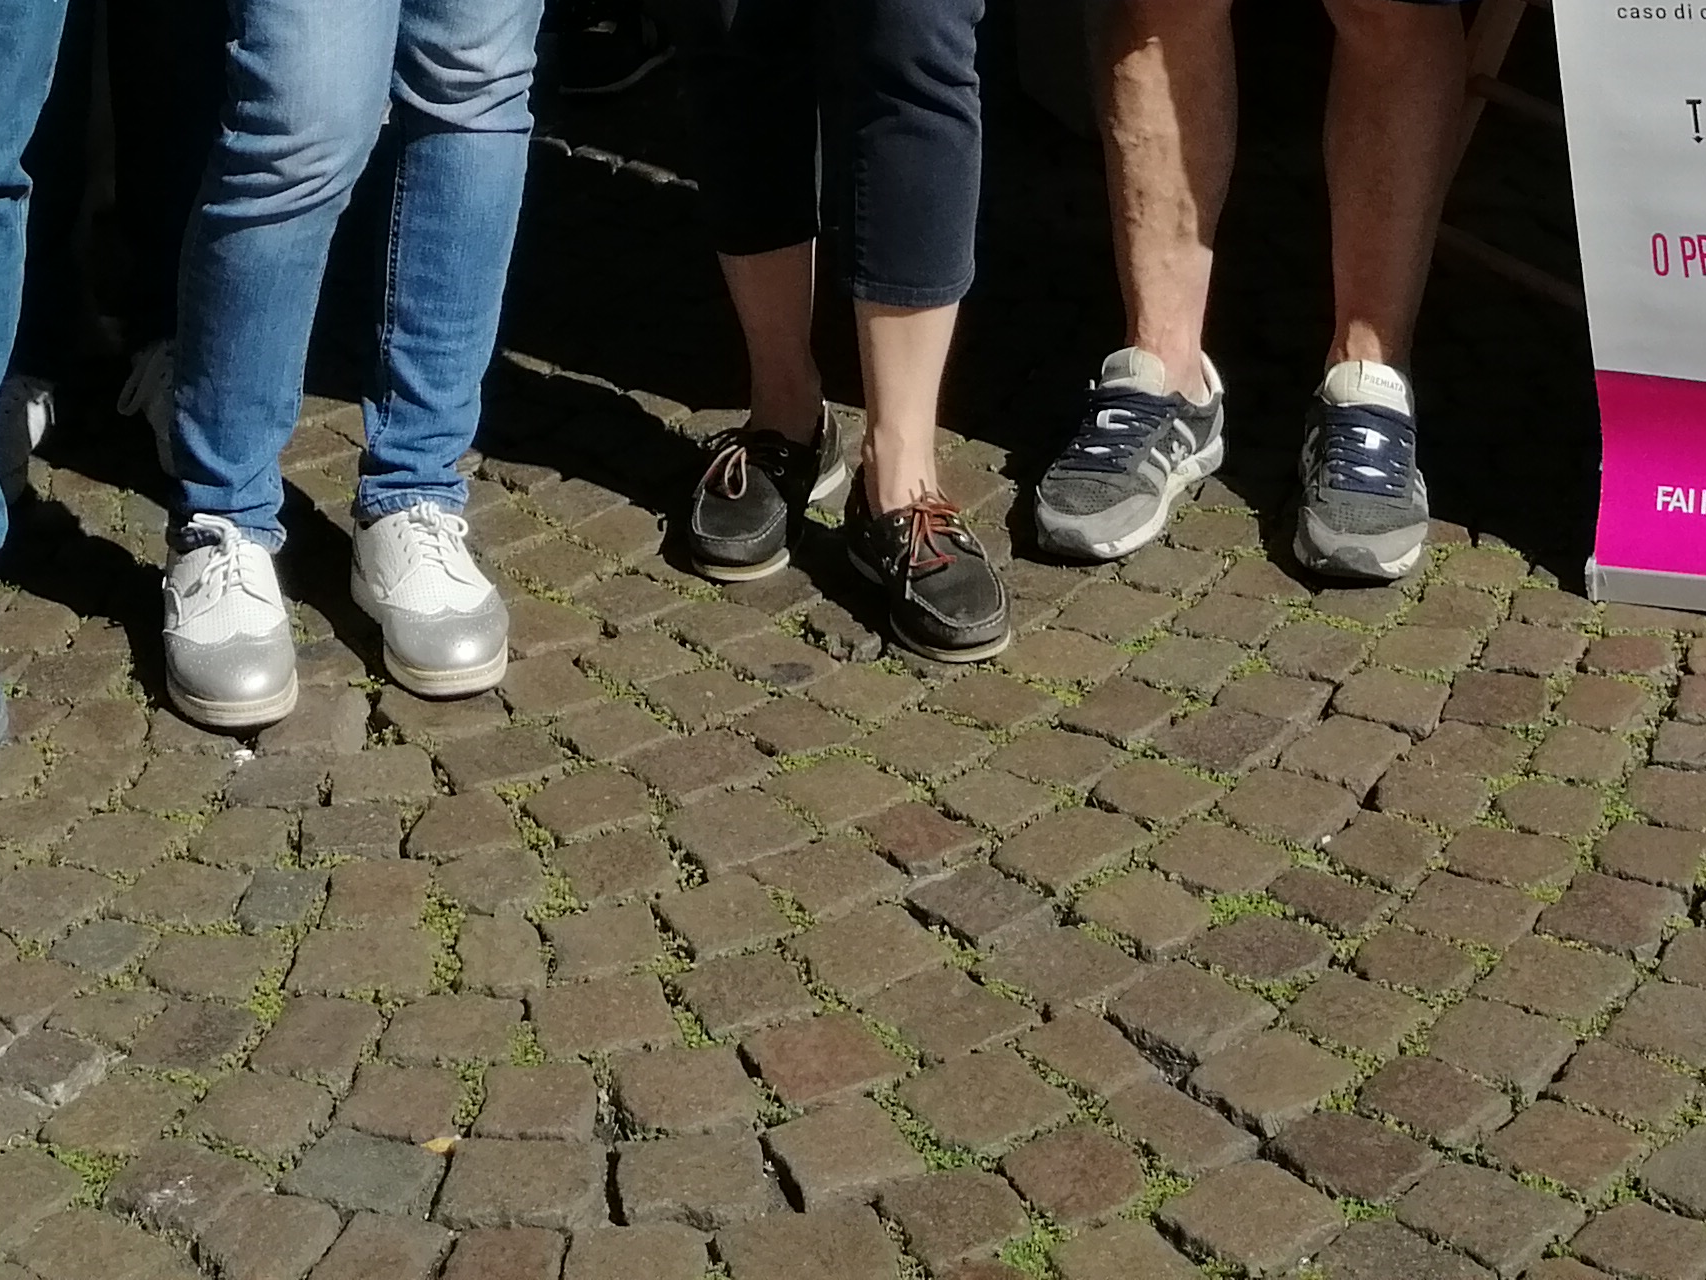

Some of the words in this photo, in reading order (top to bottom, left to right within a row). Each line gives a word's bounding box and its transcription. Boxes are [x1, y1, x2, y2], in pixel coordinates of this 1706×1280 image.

[1652, 233, 1669, 276] O
[1363, 373, 1405, 393] PREMIATA
[1657, 486, 1695, 514] FAI
